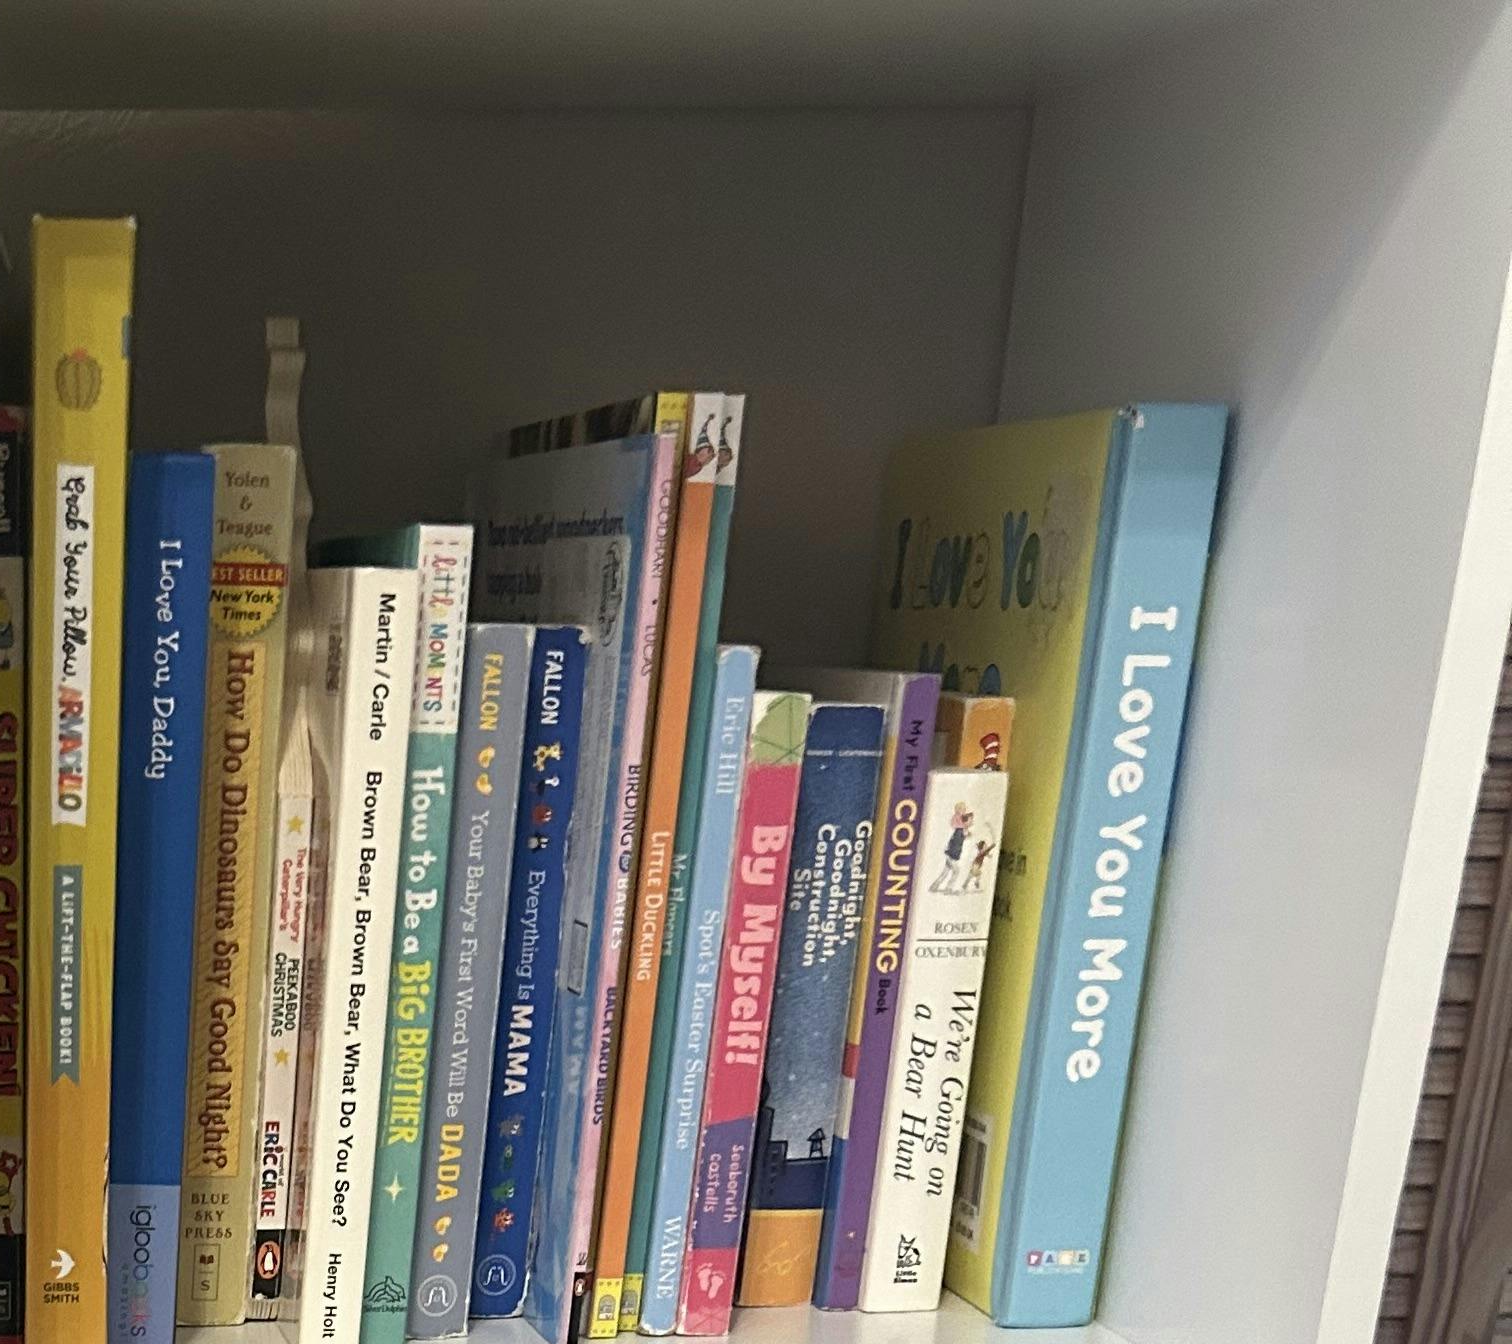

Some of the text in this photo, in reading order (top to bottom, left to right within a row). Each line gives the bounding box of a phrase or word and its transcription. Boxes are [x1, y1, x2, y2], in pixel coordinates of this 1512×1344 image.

[225, 471, 270, 488] Yolen
[240, 499, 253, 511] &
[217, 518, 273, 538] Teague
[210, 589, 274, 604] New York
[222, 606, 261, 621] Times
[238, 567, 284, 582] SELLER
[640, 479, 673, 678] GOODHART LUCAS
[57, 476, 88, 812] Grab Your ARMADILLO
[145, 539, 183, 780] I Love You, Daddy
[619, 764, 641, 853] BIRDING
[1066, 606, 1179, 1084] I Love You More
[199, 650, 256, 1170] How Do Dinosaurs Say Good Night?
[504, 649, 564, 1097] FALLON Everything Is MAMA
[789, 868, 812, 912] Site
[801, 823, 836, 968] Construction
[818, 839, 852, 964] Goodnight,
[842, 819, 873, 947] Goodnight,
[874, 719, 924, 1016] My First COUNTING Book
[290, 899, 305, 943] Hungry
[388, 765, 446, 1145] How to Be a BROTHER
[435, 652, 504, 1202] FALLON Your Baby's First Word Will Be DADA
[610, 877, 633, 950] BABIES
[724, 823, 789, 1066] By Myself!
[914, 946, 988, 959] OXENBURY
[934, 921, 979, 935] ROSEN
[58, 875, 75, 1066] A LIFT-THE-FLAP BOOK!
[271, 951, 287, 1038] CHRISTMAS
[284, 958, 300, 1031] PEEKABOO
[322, 593, 397, 1339] Martin Carle Brown Bear, Brown Bear, What Do You See? Henry Holt
[656, 695, 745, 1301] Eric Hill Spot's Easter Surprise WARNE
[893, 1003, 938, 1183] a Bear Hunt
[923, 987, 978, 1198] We're Going on
[185, 1227, 233, 1239] PRESS
[191, 1193, 230, 1205] BLUE
[195, 1210, 225, 1222] SKY
[260, 1168, 278, 1218] CARLE
[43, 1282, 80, 1293] GIBBS
[43, 1293, 80, 1304] SMITH
